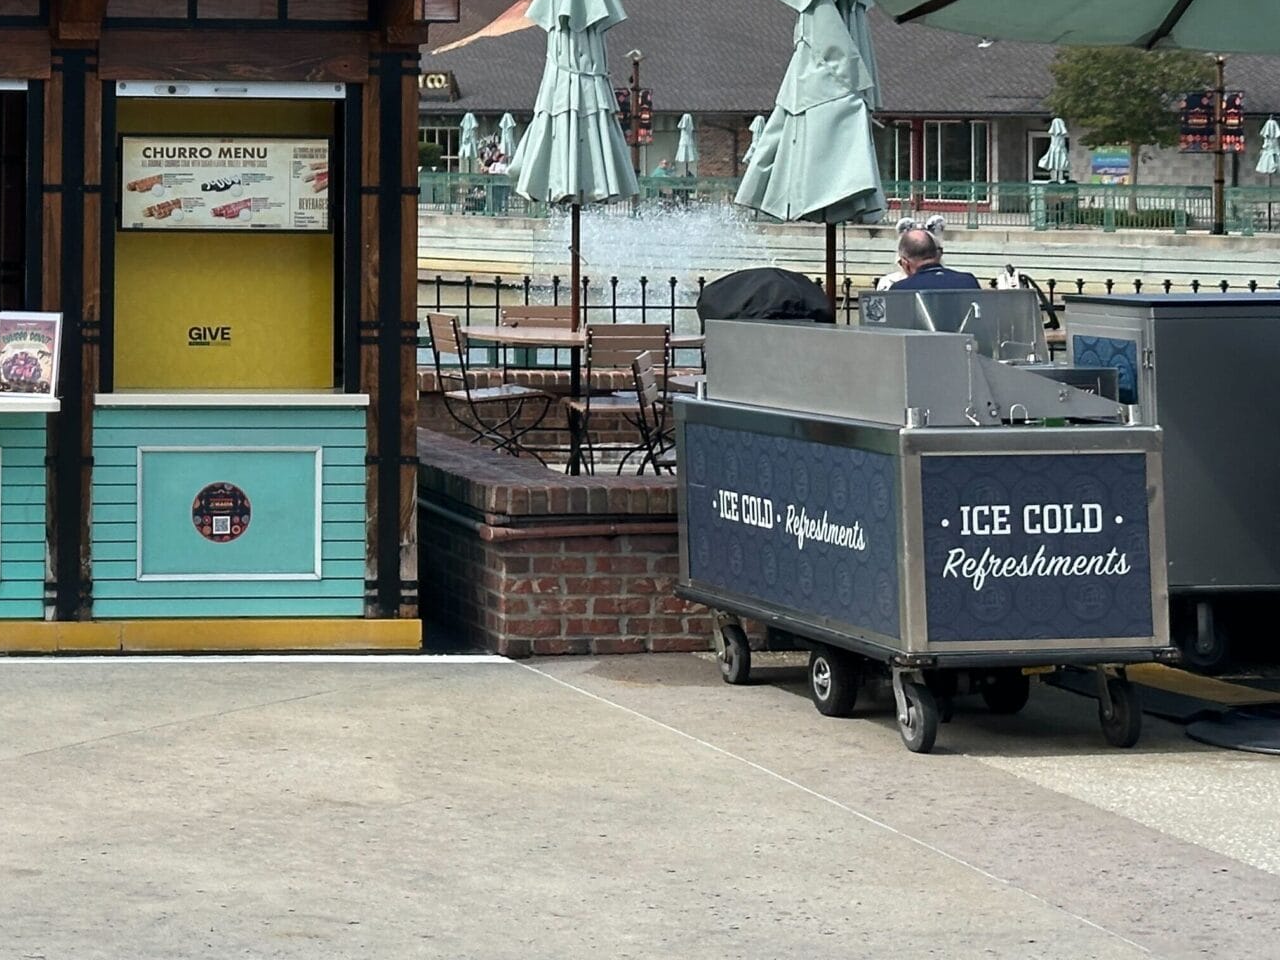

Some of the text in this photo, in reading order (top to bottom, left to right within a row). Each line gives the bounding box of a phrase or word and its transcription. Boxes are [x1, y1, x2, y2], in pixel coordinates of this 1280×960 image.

[142, 146, 268, 159] CHURRO MENU
[188, 326, 232, 340] GIVE
[719, 489, 866, 551] ICE COLD Refreshments
[959, 503, 1103, 536] ICE COLD
[942, 544, 1132, 591] Refreshments
